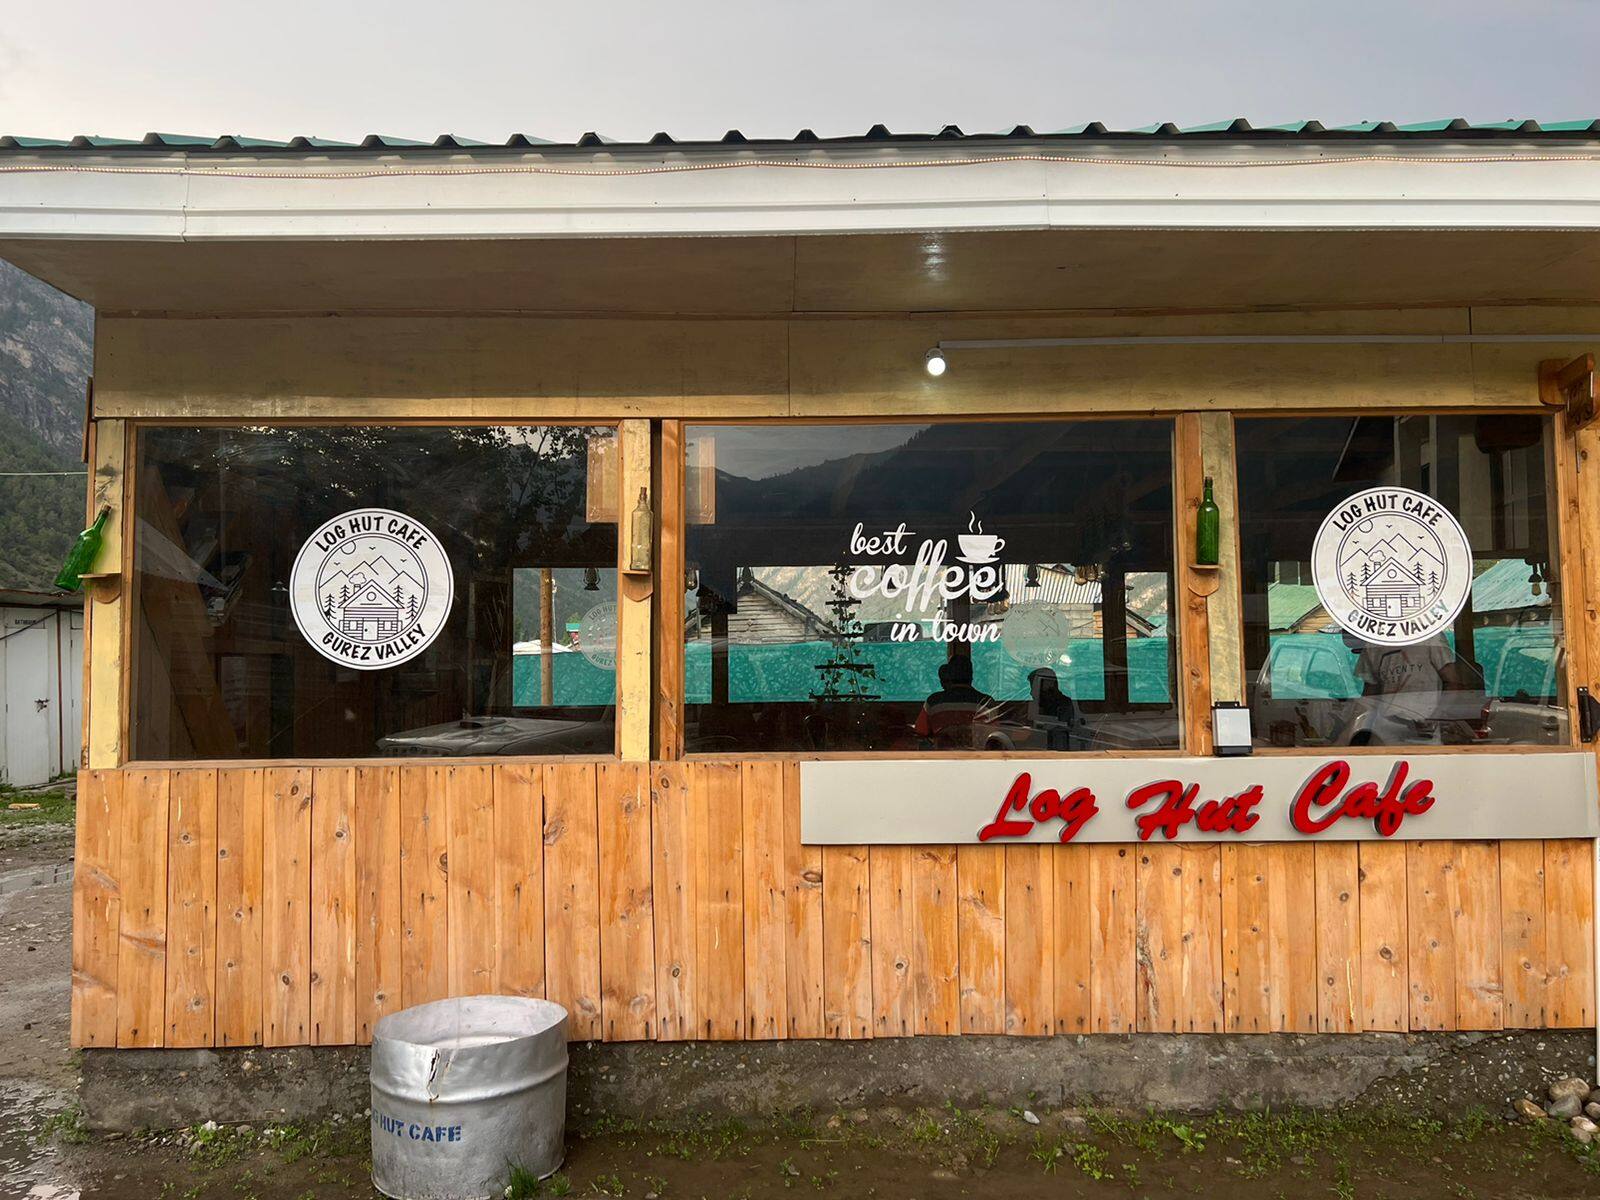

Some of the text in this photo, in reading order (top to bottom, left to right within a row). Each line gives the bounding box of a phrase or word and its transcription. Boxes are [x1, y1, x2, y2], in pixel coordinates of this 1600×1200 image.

[1332, 494, 1443, 531] LOG HUT CAFE
[315, 516, 427, 552] LOG HUT CAFE
[850, 522, 916, 556] best
[850, 539, 1003, 612] coffee
[890, 613, 919, 642] in
[921, 609, 1001, 642] town
[1347, 598, 1449, 637] GUREZ VALLEY
[322, 623, 426, 660] GUREZ VALLEY
[977, 760, 1436, 842] Log Hut Cafe
[380, 1114, 404, 1136] HUT
[409, 1124, 462, 1141] CAFE
